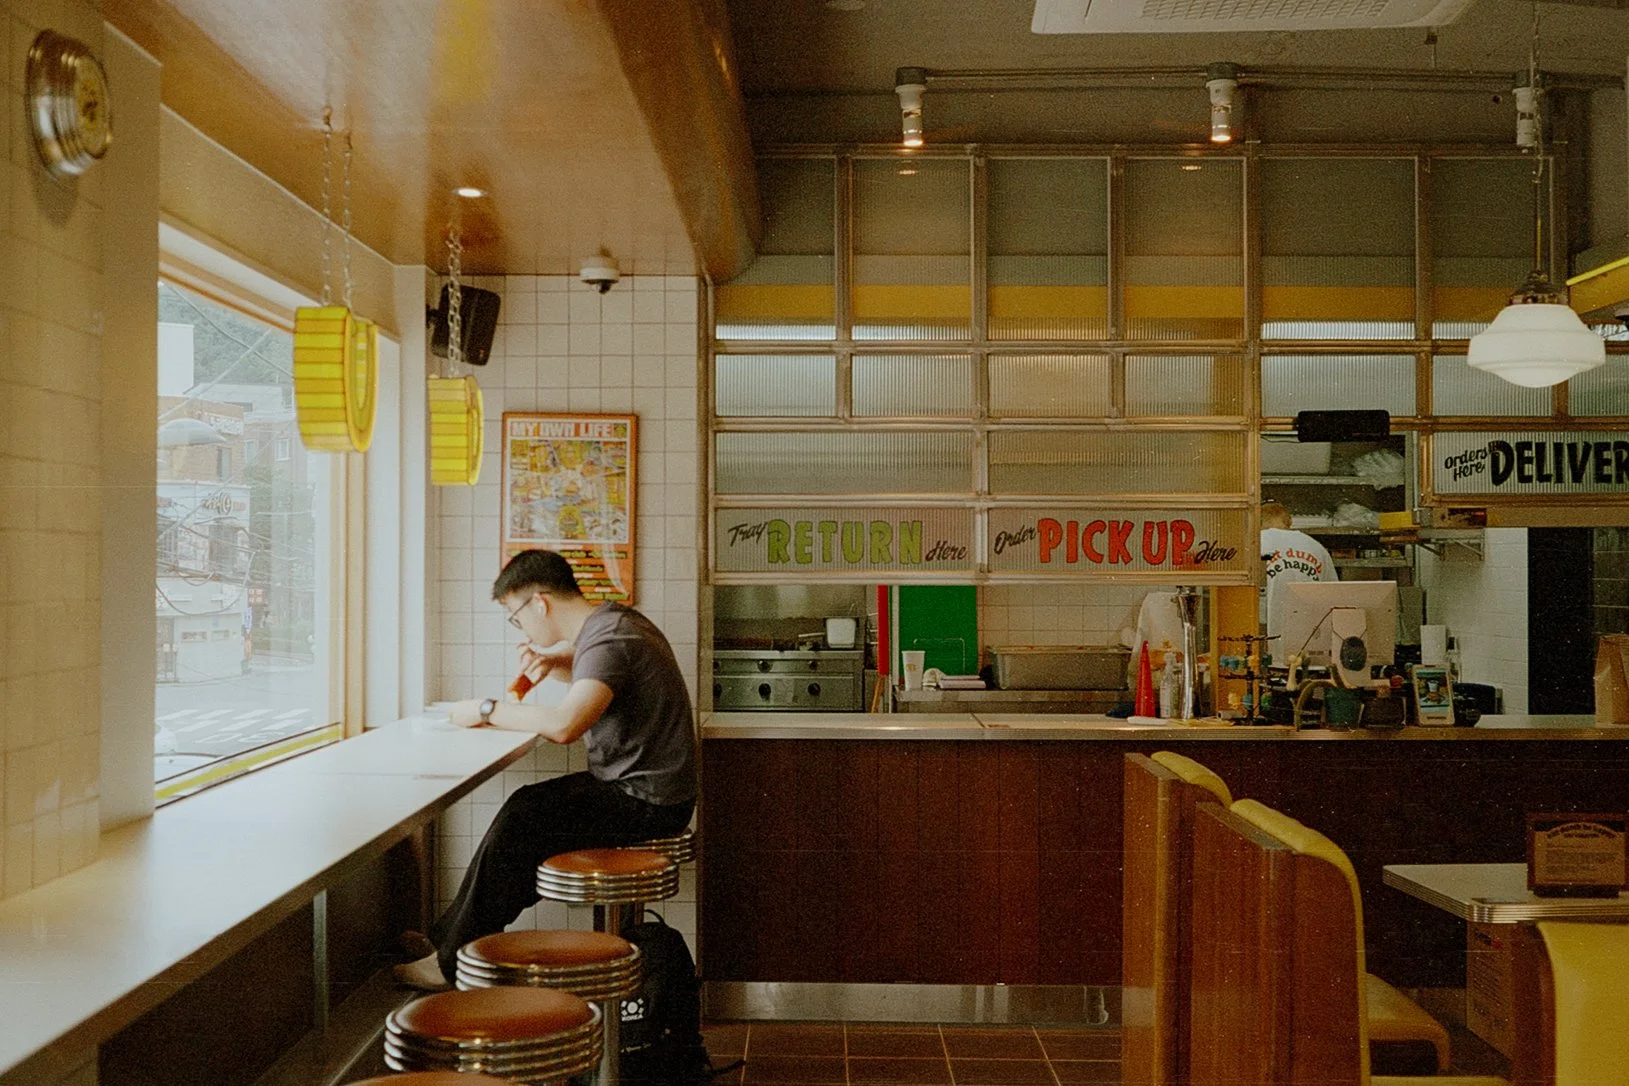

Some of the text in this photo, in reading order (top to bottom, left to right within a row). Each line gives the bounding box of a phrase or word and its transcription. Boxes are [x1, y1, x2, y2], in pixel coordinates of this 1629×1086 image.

[512, 421, 612, 437] MY OWN LIFE
[1444, 448, 1488, 470] Orders
[1453, 464, 1487, 482] Here
[727, 518, 968, 565] Tray RETURN Here
[993, 517, 1238, 566] Order PICK UP Here
[1266, 565, 1283, 579] be
